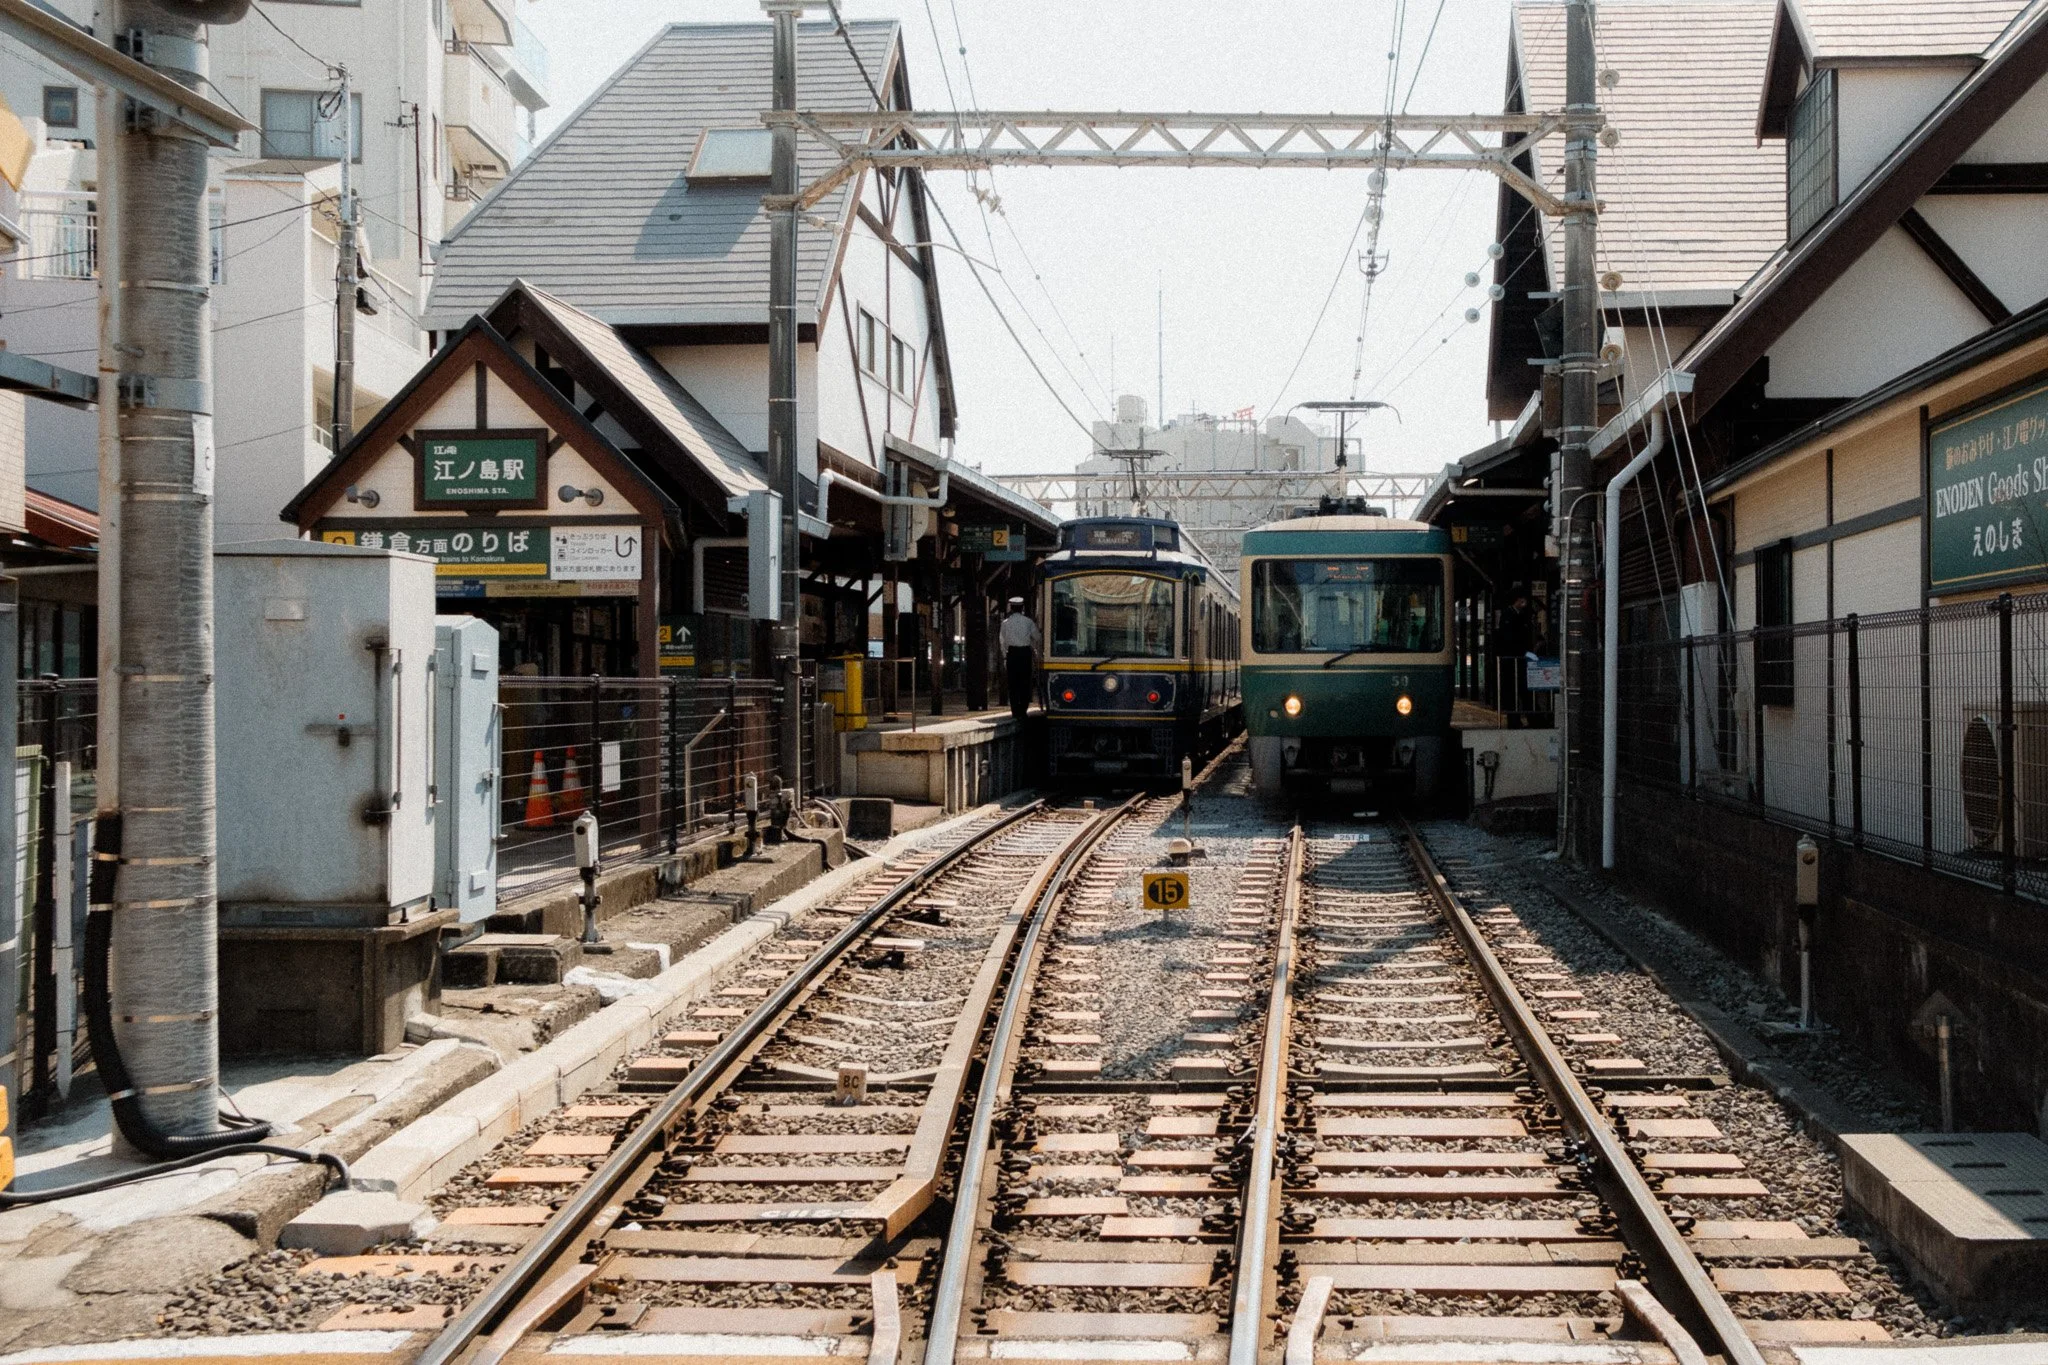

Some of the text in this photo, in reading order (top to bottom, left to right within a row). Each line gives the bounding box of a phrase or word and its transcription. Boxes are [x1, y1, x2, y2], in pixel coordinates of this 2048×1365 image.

[433, 459, 524, 480] 江ノ島駅
[446, 487, 509, 495] ENOSHIMA STA.
[1936, 476, 1984, 518] ENODEN
[1988, 463, 2029, 505] Goods
[360, 531, 529, 553] 鎌倉方面のりば
[996, 531, 1004, 544] 2
[1973, 517, 2022, 557] えのしま
[441, 555, 461, 563] trains
[470, 555, 505, 563] Kamakura
[659, 628, 668, 639] 2
[1155, 880, 1178, 903] 15
